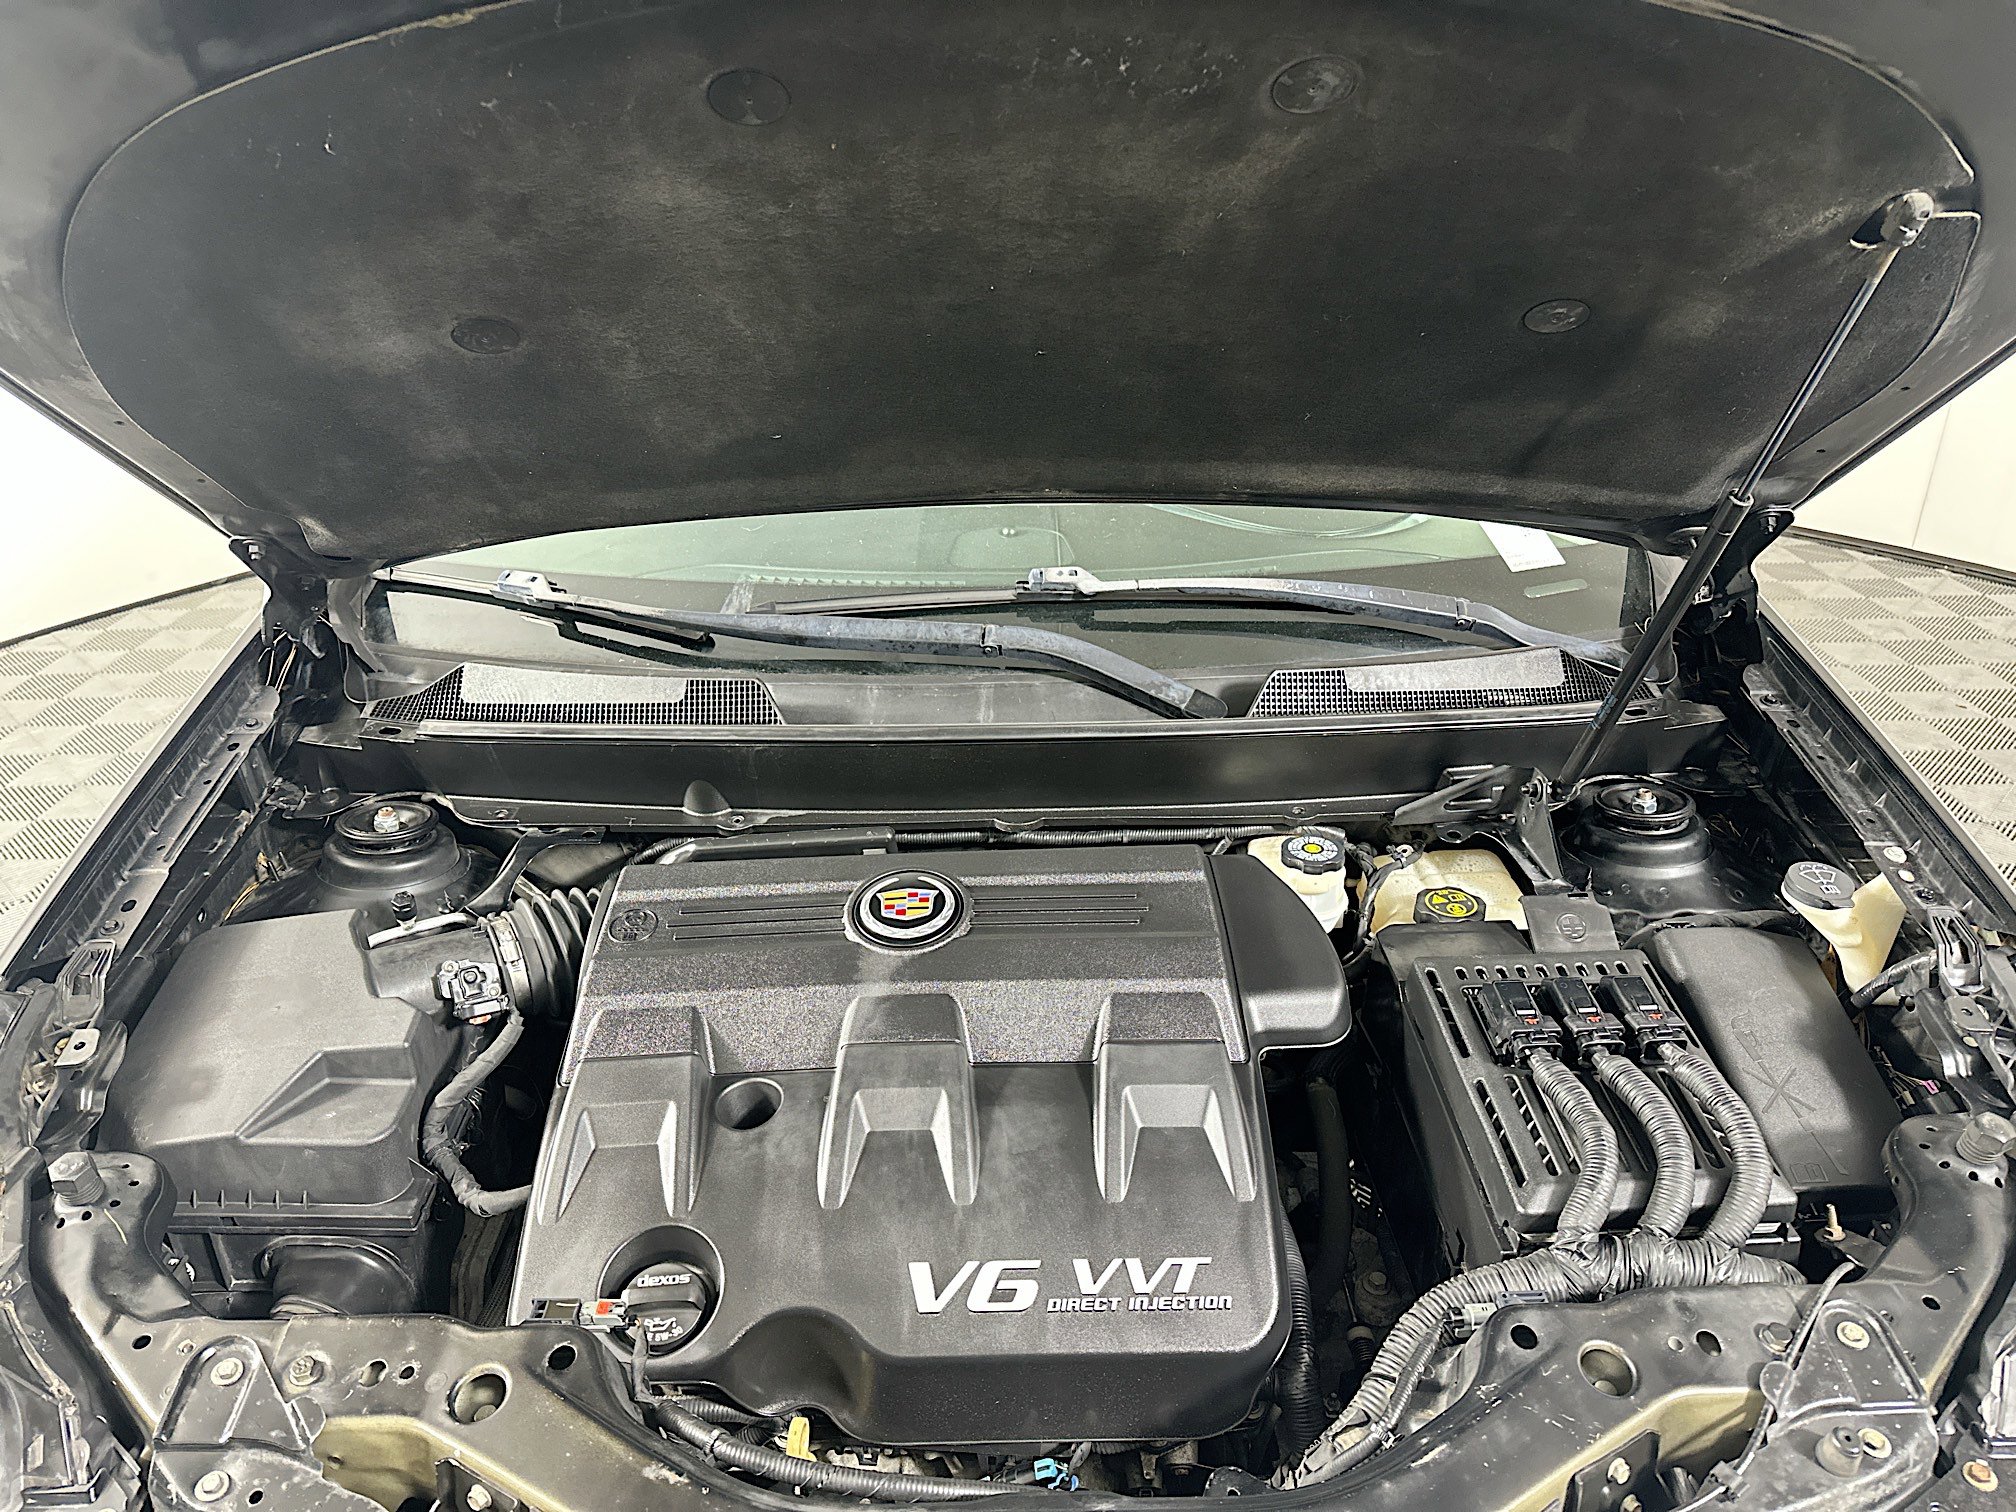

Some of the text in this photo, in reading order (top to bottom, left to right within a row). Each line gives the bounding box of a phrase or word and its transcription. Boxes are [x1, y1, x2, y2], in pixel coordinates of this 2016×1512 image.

[637, 1274, 693, 1288] dexos
[908, 1256, 1213, 1314] V6 VVT
[1047, 1295, 1233, 1313] DIRECT INJECTION
